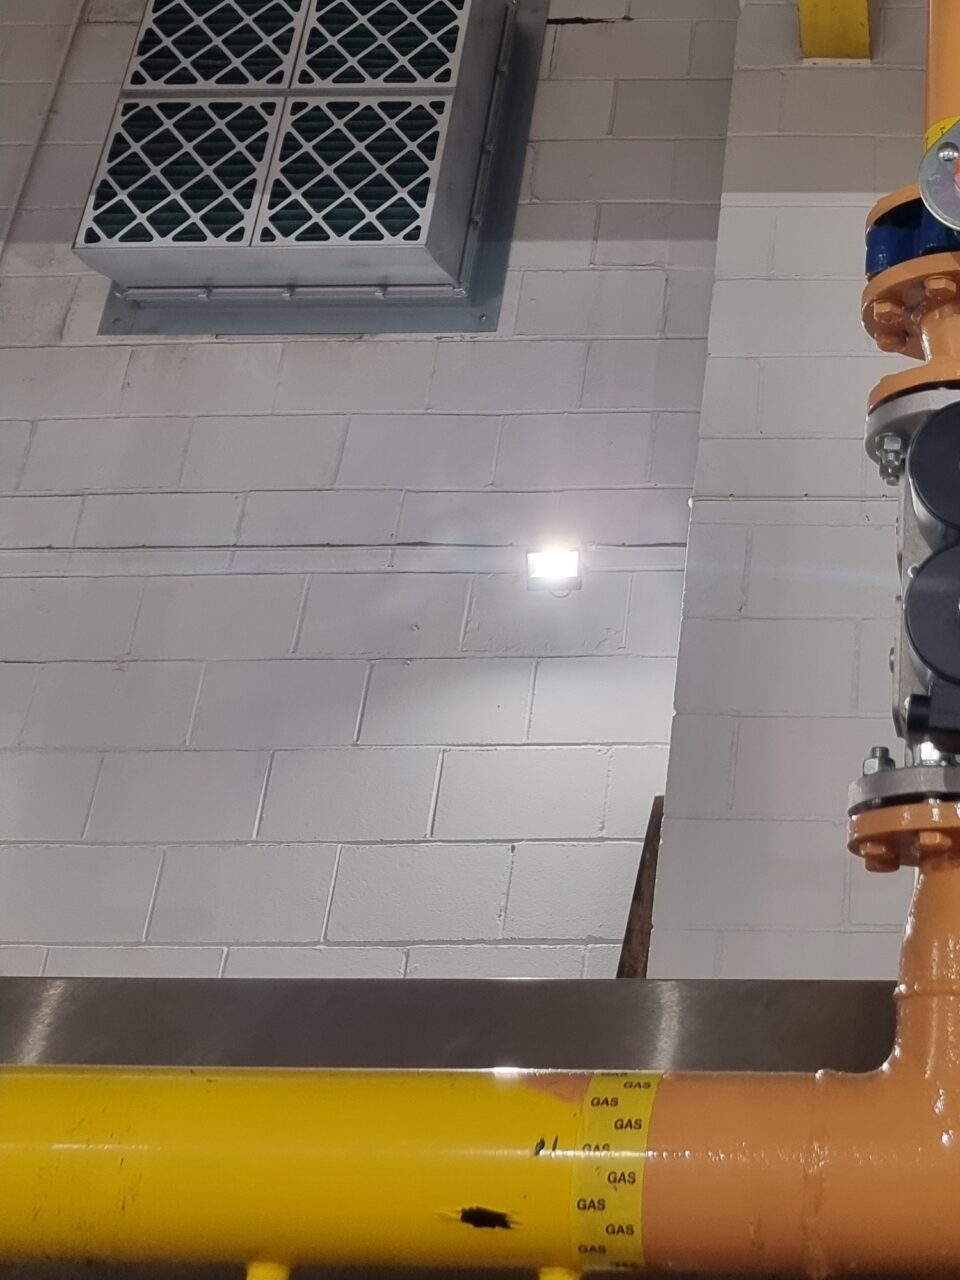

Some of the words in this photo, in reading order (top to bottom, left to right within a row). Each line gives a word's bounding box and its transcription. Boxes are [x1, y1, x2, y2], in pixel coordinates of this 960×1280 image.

[624, 1081, 651, 1089] GAS
[591, 1097, 619, 1107] GAS
[614, 1118, 643, 1130] GAS
[607, 1171, 636, 1184] GAS
[577, 1199, 606, 1211] GAS
[605, 1224, 634, 1236] GAS
[578, 1244, 607, 1254] GAS
